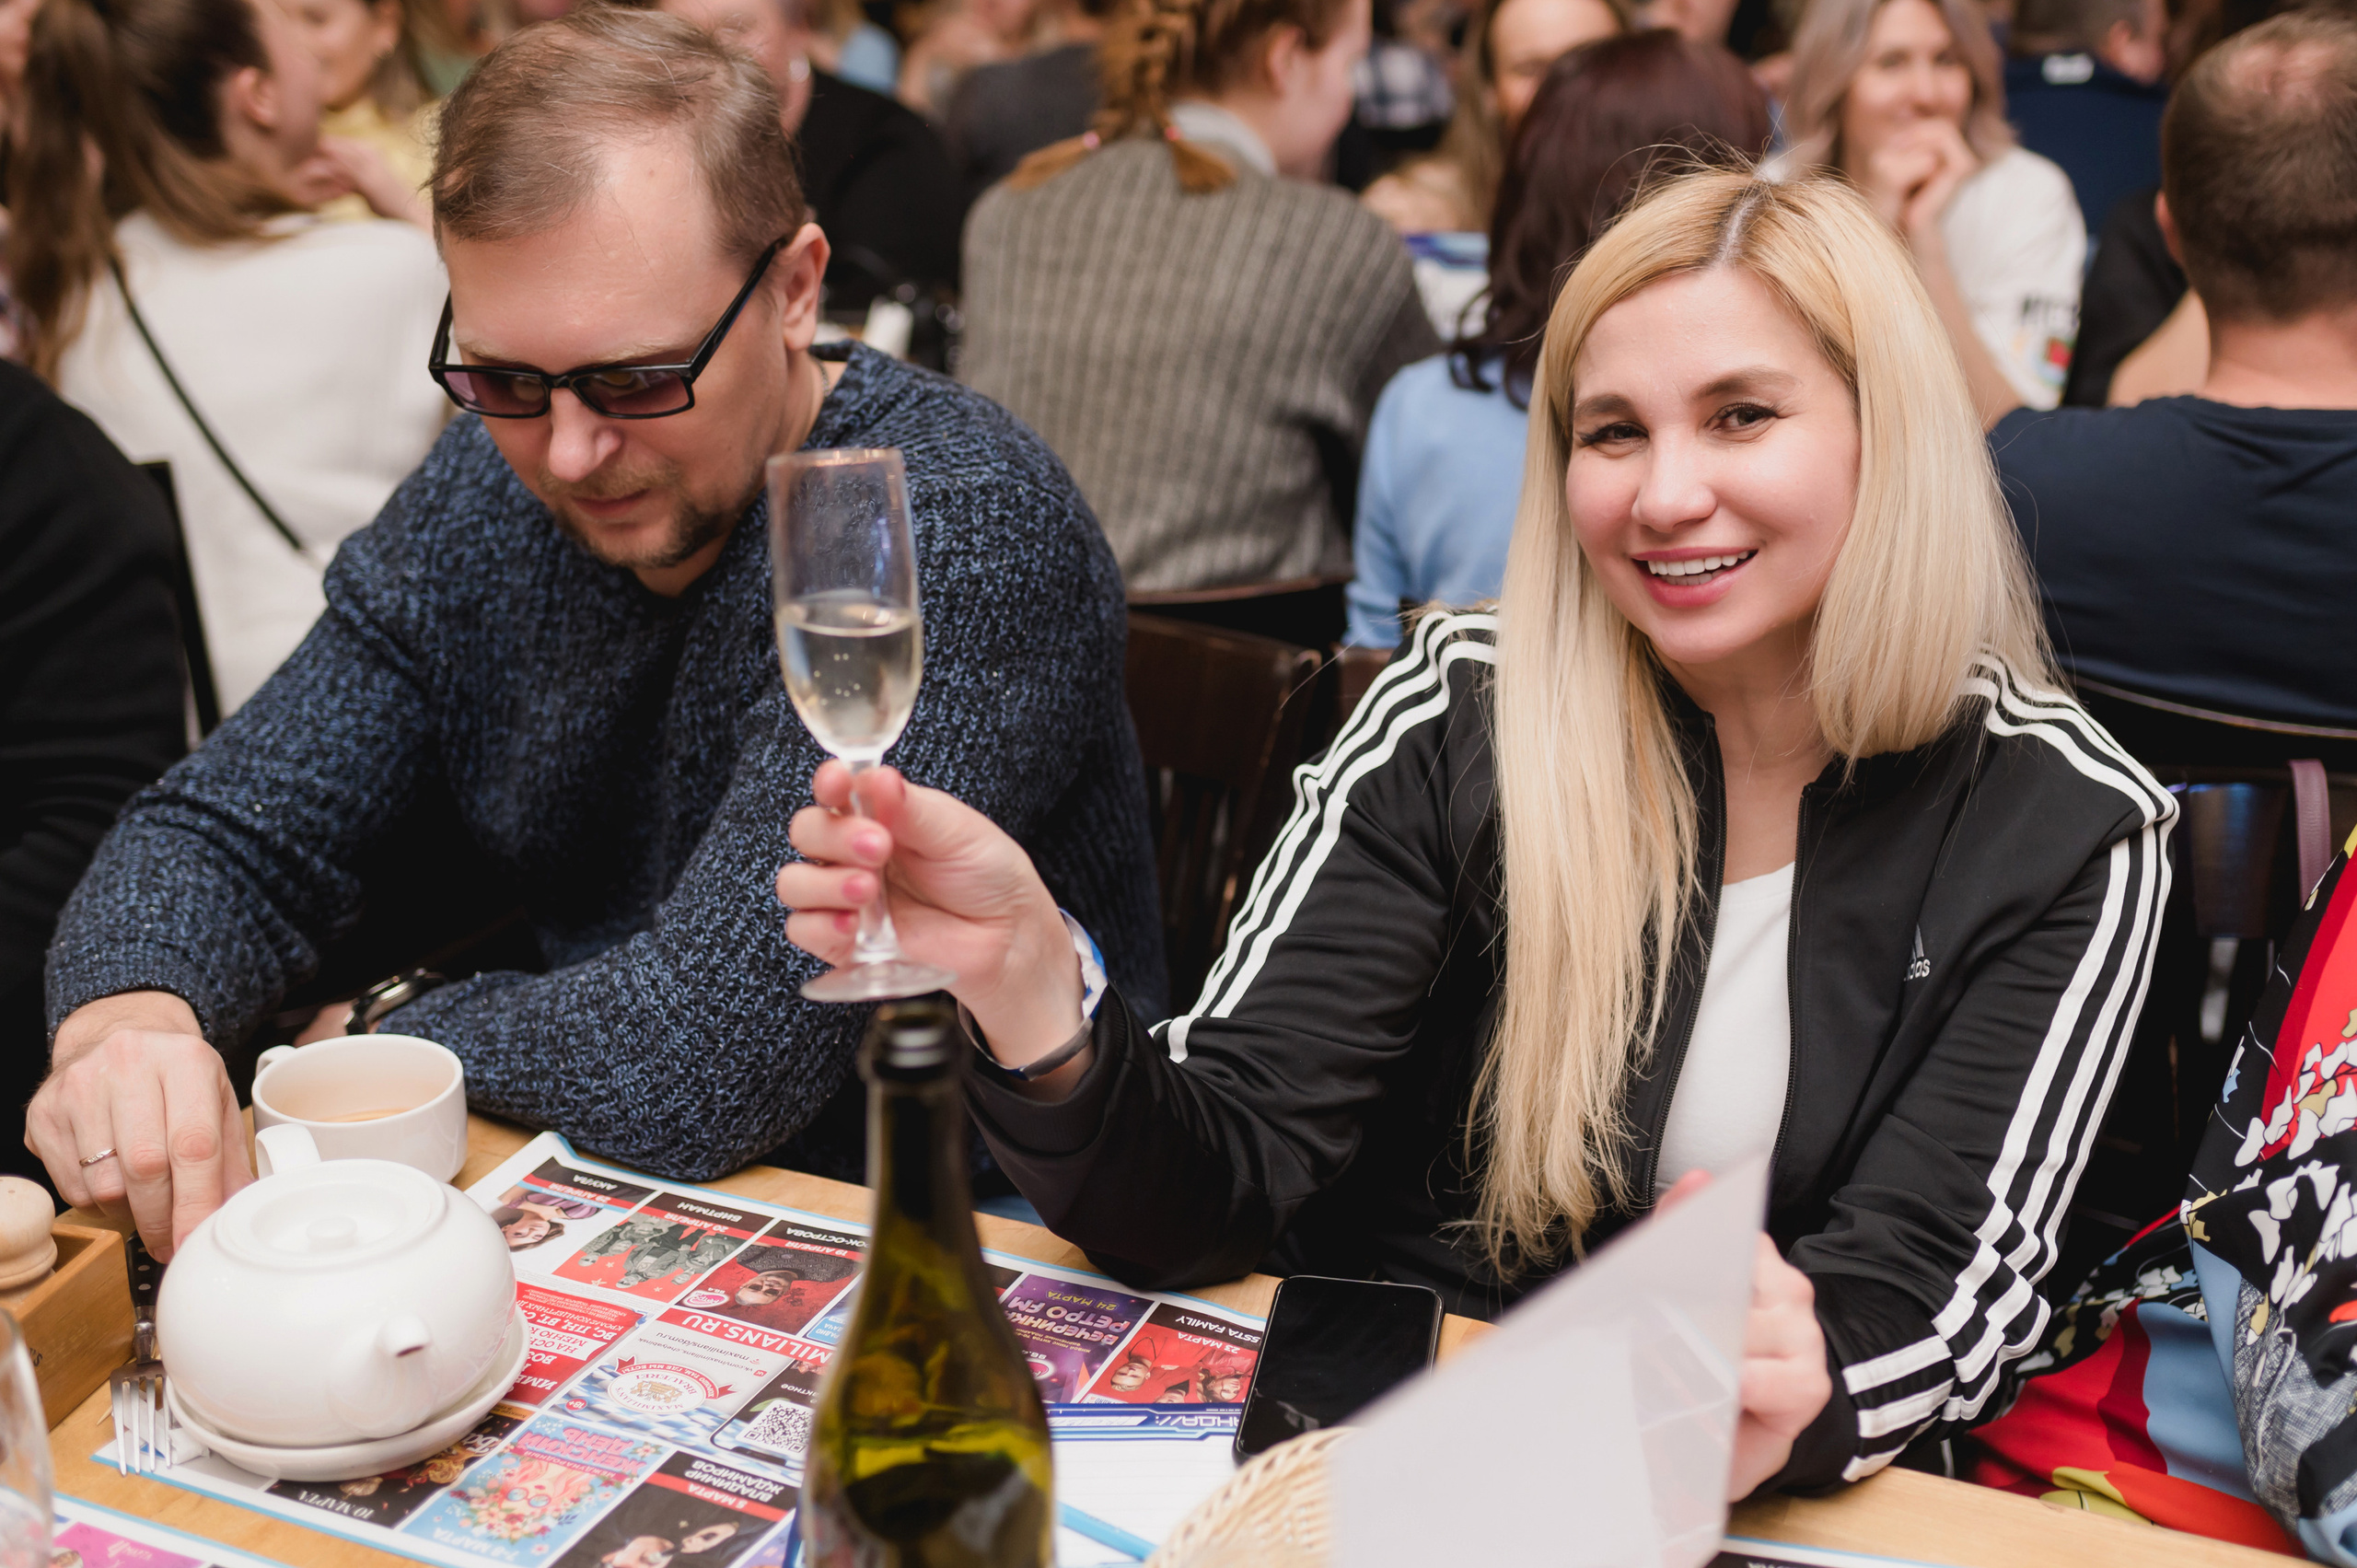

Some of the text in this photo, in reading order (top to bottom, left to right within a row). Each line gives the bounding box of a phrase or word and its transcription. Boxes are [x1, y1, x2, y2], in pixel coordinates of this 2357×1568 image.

[548, 1182, 597, 1200] АПРЕЛЯ
[573, 1174, 618, 1191] АКУЛА
[664, 1212, 729, 1233] 20 АПРЕЛЯ
[677, 1202, 743, 1223] БИРТМАН
[784, 1241, 848, 1257] 19 АПРЕЛЯ
[1047, 1291, 1117, 1311] 24 МАРТА
[526, 1303, 591, 1324] КОНЦЕРТНЫХ
[537, 1313, 562, 1326] ВТ,
[1007, 1295, 1131, 1333] РЕТРО FM
[562, 1319, 591, 1334] ПН,
[589, 1319, 624, 1331] КРОМЕ
[592, 1327, 618, 1341] ВС,
[1175, 1315, 1261, 1343] 5STA FAMILY
[540, 1330, 587, 1347] МЕНЮ
[556, 1342, 578, 1353] НА
[656, 1332, 749, 1361] maximilians/dom.ru
[681, 1315, 832, 1364] MILIANS.RU
[1178, 1332, 1240, 1354] 23 МАРТА
[621, 1365, 647, 1374] ЕСТЬ!
[635, 1373, 697, 1395] BRAUEREI
[568, 1400, 586, 1410] 18+
[563, 1426, 634, 1456] ДЕНЬ
[517, 1430, 647, 1476] ЖЕНСКИЙ
[524, 1450, 616, 1478] МЕЖДУНАРОДНЫЙ
[684, 1469, 773, 1503] ВЛАДИМИР
[691, 1460, 785, 1495] ЖДАМИРОВ
[296, 1490, 355, 1515] МАРТА
[688, 1483, 737, 1505] МАРТА
[433, 1527, 492, 1553] МАРТА
